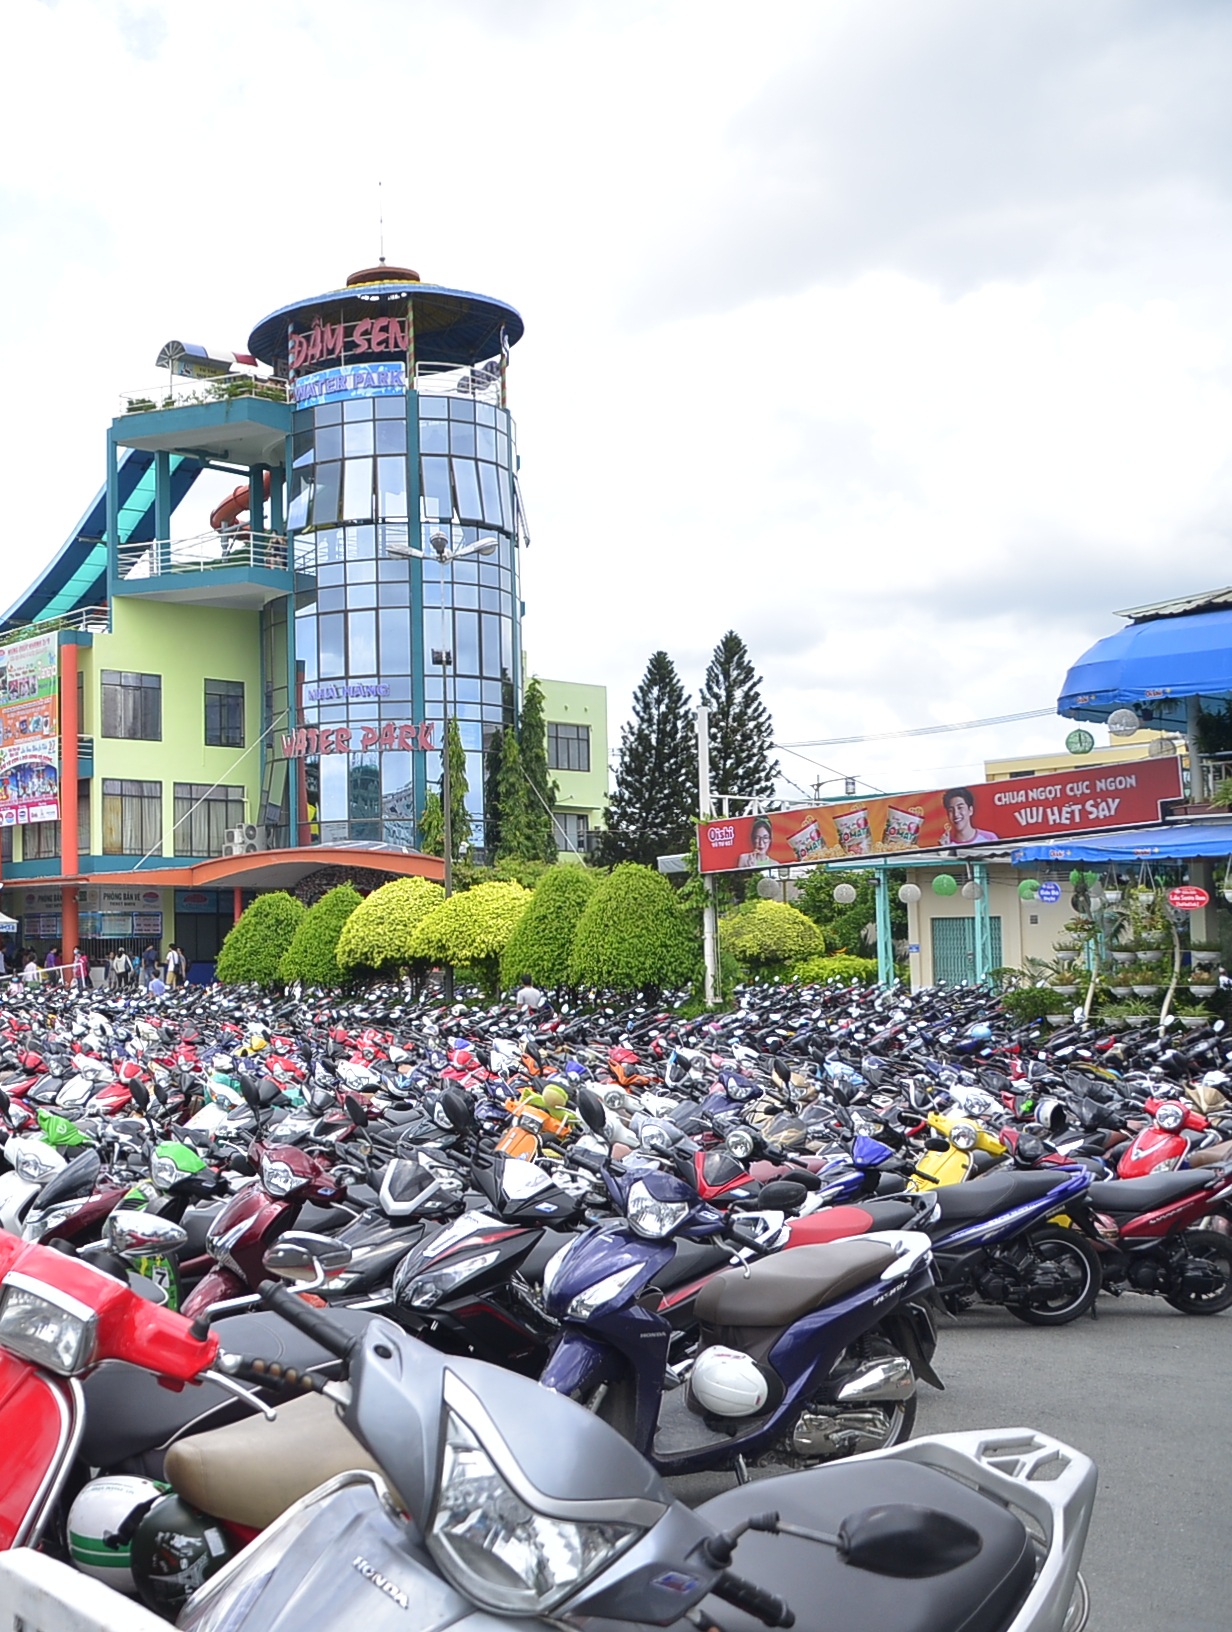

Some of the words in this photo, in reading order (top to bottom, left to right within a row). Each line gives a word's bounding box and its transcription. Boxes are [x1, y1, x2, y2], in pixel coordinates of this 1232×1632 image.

[352, 317, 409, 354] SEN
[294, 374, 350, 402] WATER
[352, 370, 406, 388] PARK
[281, 727, 352, 758] WATER
[360, 721, 436, 753] PARK
[994, 789, 1026, 806] CHUA
[1028, 785, 1062, 801] NGỌT
[1066, 780, 1091, 797] CỰC
[1096, 774, 1137, 792] NGON
[1014, 806, 1045, 827] VUI
[1046, 802, 1083, 826] HẾT
[708, 825, 735, 843] Oishi
[155, 1271, 167, 1286] 7
[352, 1556, 409, 1610] HONDA
